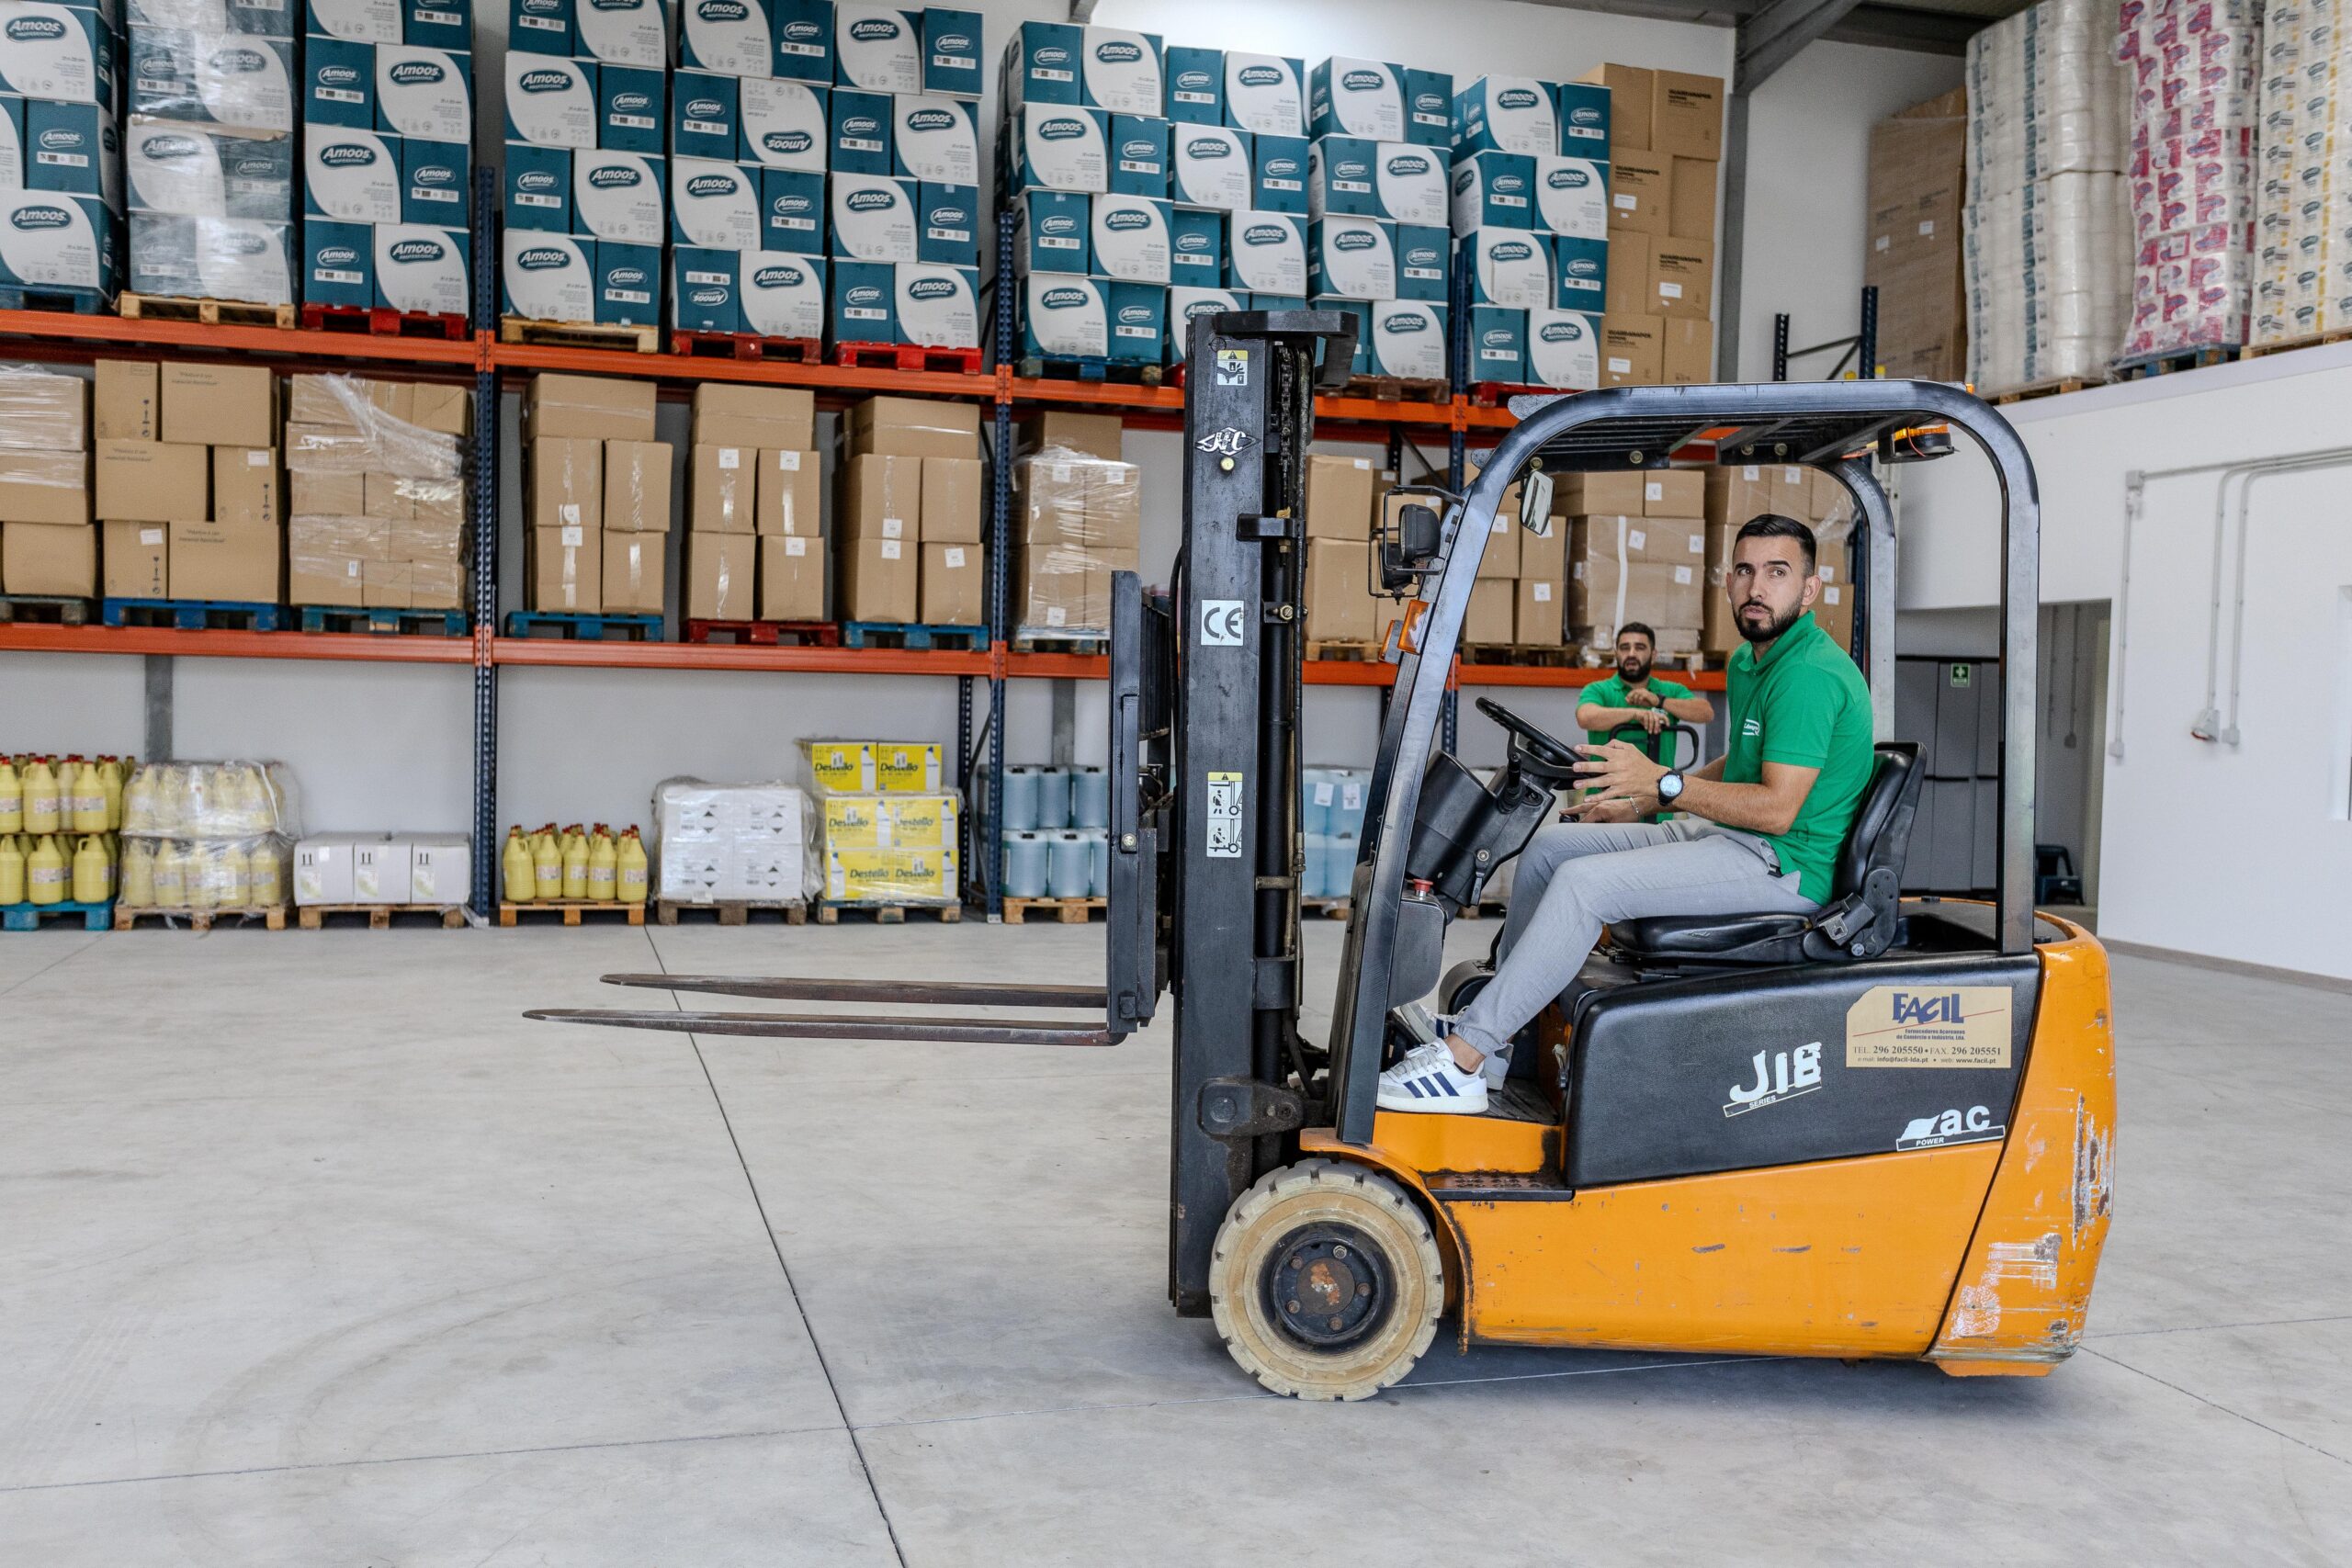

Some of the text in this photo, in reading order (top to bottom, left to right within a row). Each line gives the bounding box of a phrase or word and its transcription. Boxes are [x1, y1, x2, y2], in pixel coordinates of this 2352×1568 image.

[700, 4, 744, 15] Amoos
[9, 20, 61, 32] Amoos
[787, 25, 819, 33] Amoos
[854, 24, 896, 33] Amoos
[1037, 51, 1068, 59] Amoos
[1099, 46, 1138, 55] Amoos
[322, 69, 356, 78] Amoos
[392, 65, 440, 75] Amoos
[1241, 70, 1281, 79] Amoos
[523, 74, 569, 85] Amoos
[1343, 74, 1381, 84] Amoos
[616, 96, 648, 105] Amoos
[1499, 93, 1536, 101] Amoos
[689, 103, 720, 111] Amoos
[910, 114, 953, 124] Amoos
[1042, 123, 1084, 132] Amoos
[43, 132, 80, 141] Amoos
[767, 140, 809, 150] Amoos
[1189, 142, 1228, 152] Amoos
[323, 148, 371, 158] Amoos
[1390, 160, 1427, 169] Amoos
[419, 169, 451, 177] Amoos
[592, 170, 637, 180] Amoos
[1550, 173, 1587, 182] Amoos
[521, 175, 554, 184] Amoos
[690, 179, 733, 189] Amoos
[849, 194, 891, 204] Amoos
[15, 210, 65, 220] Amoos
[1108, 214, 1148, 223] Amoos
[1246, 229, 1284, 238] Amoos
[1337, 234, 1373, 243] Amoos
[392, 244, 439, 254] Amoos
[1493, 245, 1529, 254] Amoos
[520, 252, 566, 262] Amoos
[757, 270, 799, 280] Amoos
[911, 282, 953, 292] Amoos
[1045, 292, 1085, 301] Amoos
[1386, 317, 1424, 326] Amoos
[1543, 326, 1579, 334] Amoos
[1204, 607, 1241, 638] CE
[815, 762, 853, 772] Deselo
[880, 763, 918, 772] Deselo
[829, 818, 868, 827] Desello
[850, 869, 888, 878] Destello
[895, 869, 934, 878] Deselo
[1853, 1046, 2001, 1055] TEL. 296 205550 FAX. 296 205551
[1748, 1095, 1776, 1109] SERIES
[1939, 1105, 1990, 1136] ac
[1916, 1137, 1945, 1146] POWER
